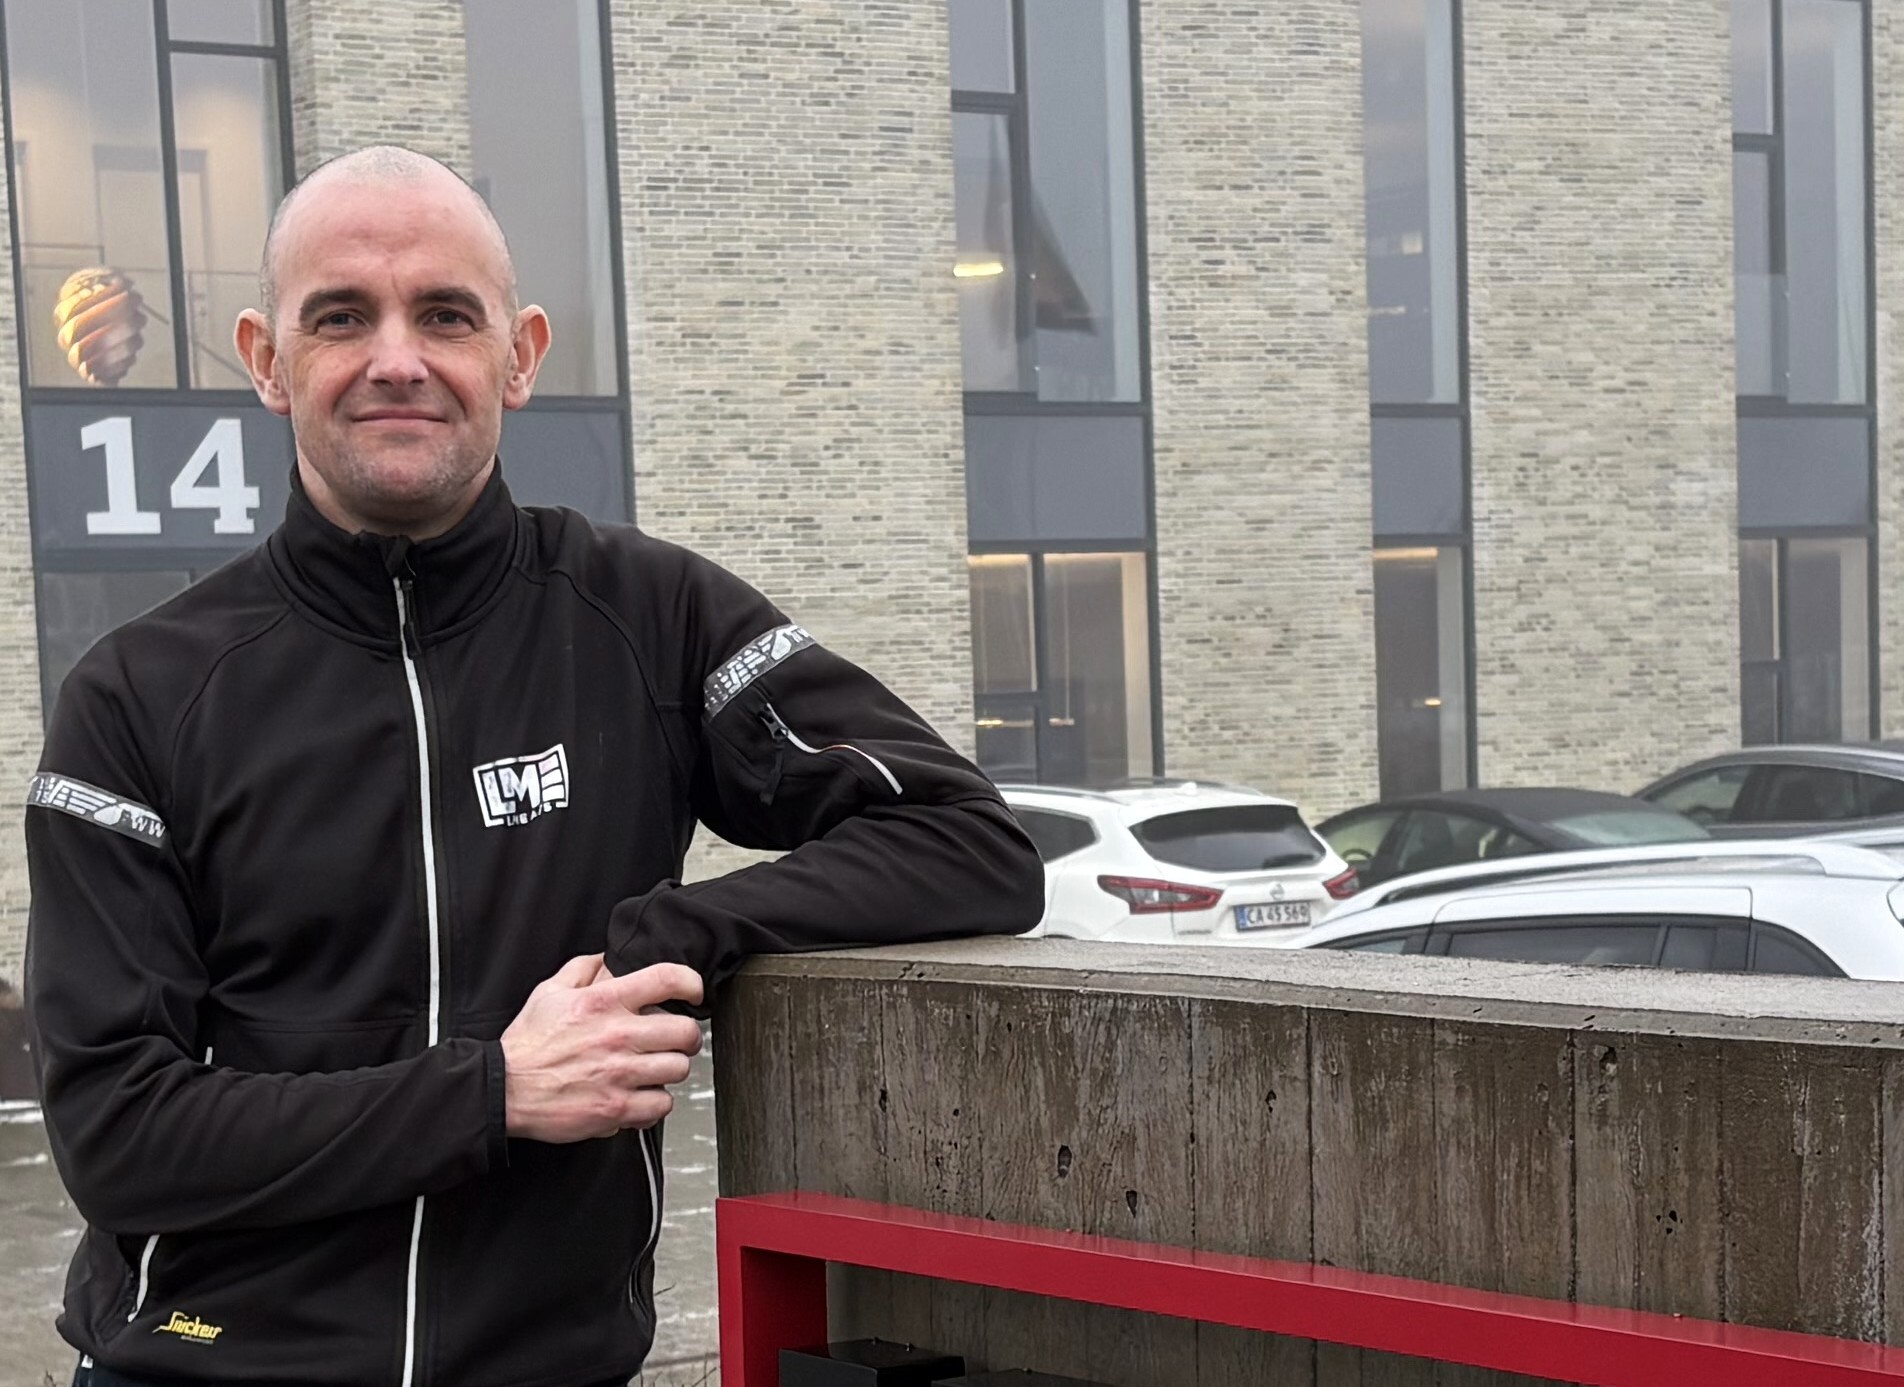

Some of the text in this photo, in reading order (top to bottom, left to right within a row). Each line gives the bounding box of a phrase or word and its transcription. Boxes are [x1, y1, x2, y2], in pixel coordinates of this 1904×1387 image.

[81, 416, 260, 535] 14
[481, 753, 565, 816] LME
[1247, 906, 1264, 924] CA
[1267, 904, 1281, 922] 45
